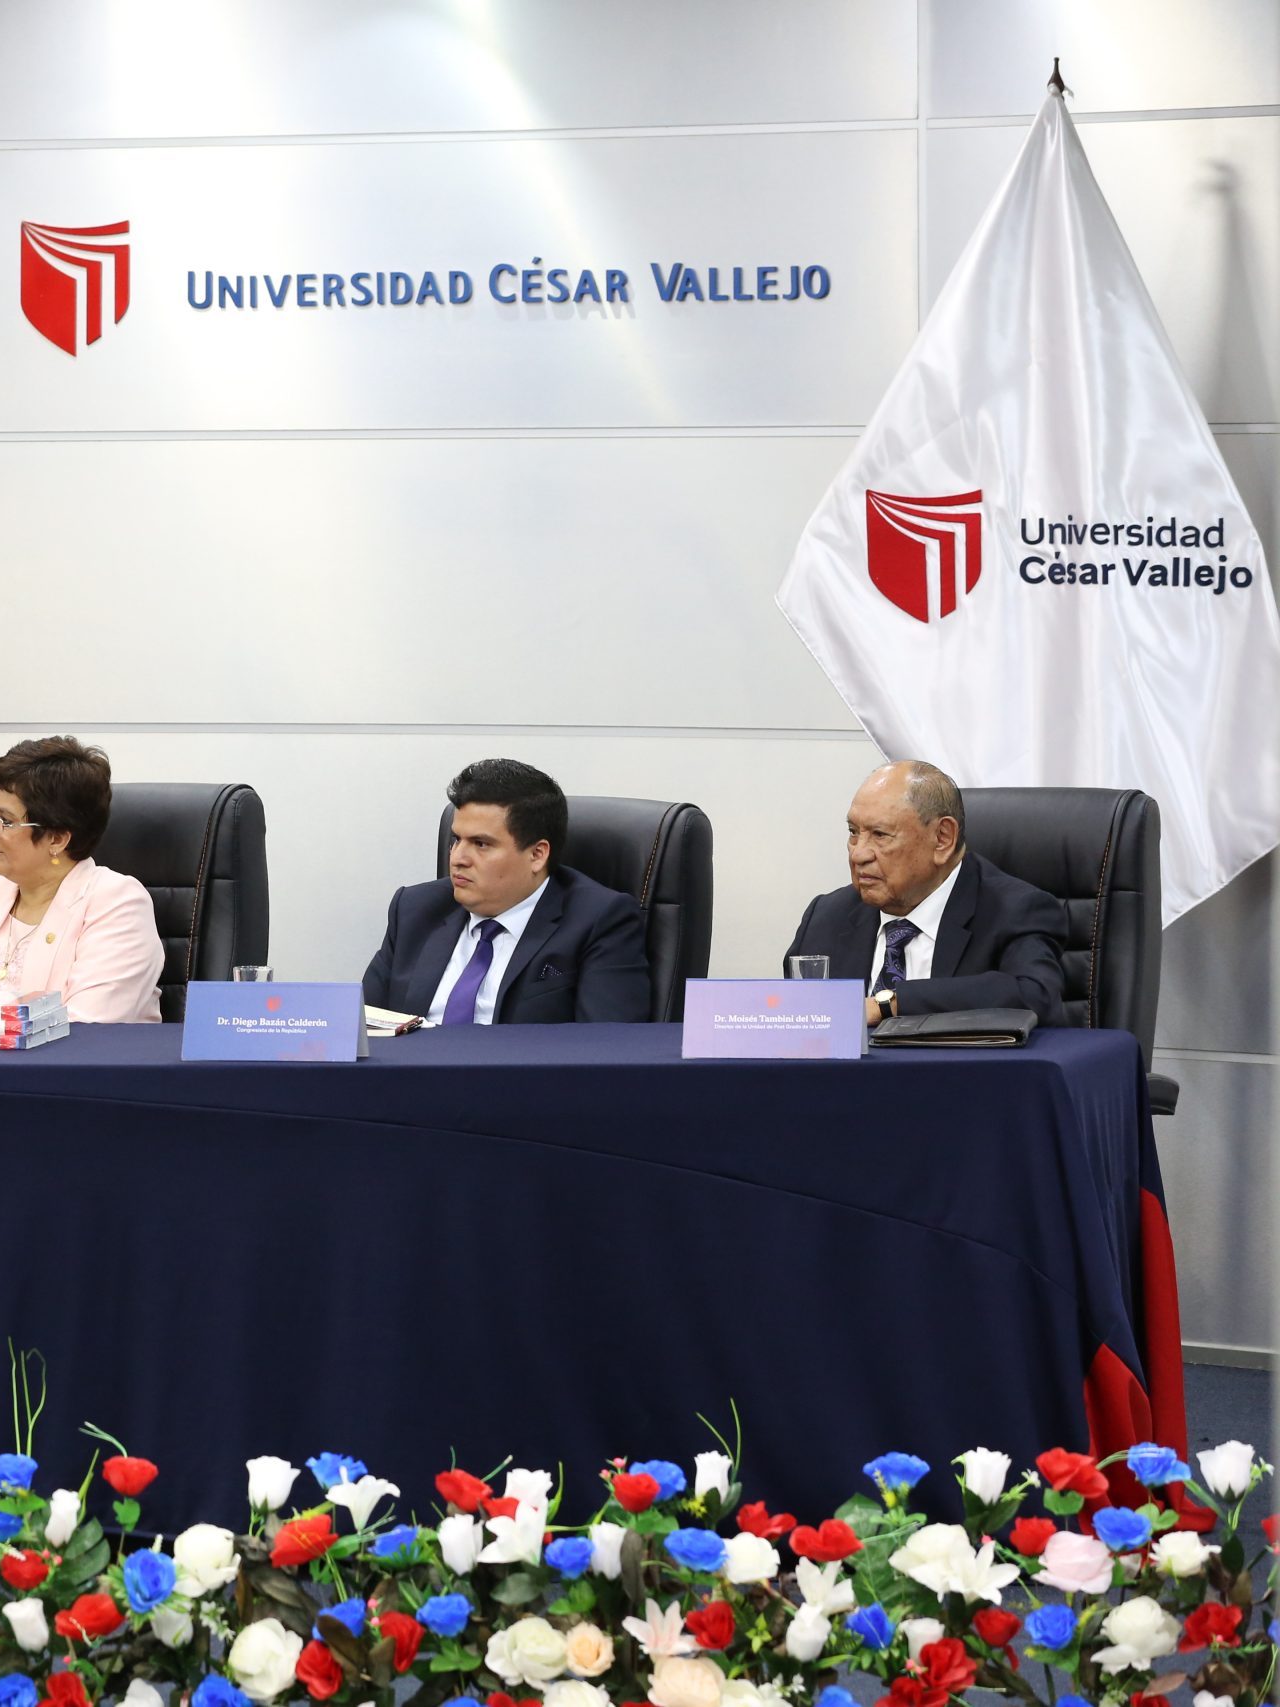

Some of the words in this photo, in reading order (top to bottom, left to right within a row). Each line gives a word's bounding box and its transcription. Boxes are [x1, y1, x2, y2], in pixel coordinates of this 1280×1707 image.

[186, 270, 474, 309] UNIVERSIDAD
[488, 256, 630, 304] CÉSAR
[650, 262, 832, 302] VALLEJO
[1020, 514, 1225, 548] Universidad
[1019, 551, 1116, 585] César
[1122, 554, 1253, 596] Vallejo
[217, 1017, 230, 1025] Dr.
[232, 1017, 257, 1028] Diego
[259, 1018, 286, 1027] Bazán
[287, 1018, 328, 1027] Calderón
[714, 1014, 727, 1023] Dr.
[728, 1014, 757, 1023] Moisés
[759, 1014, 794, 1023] Tambini
[795, 1014, 808, 1023] del
[810, 1014, 832, 1023] Valle
